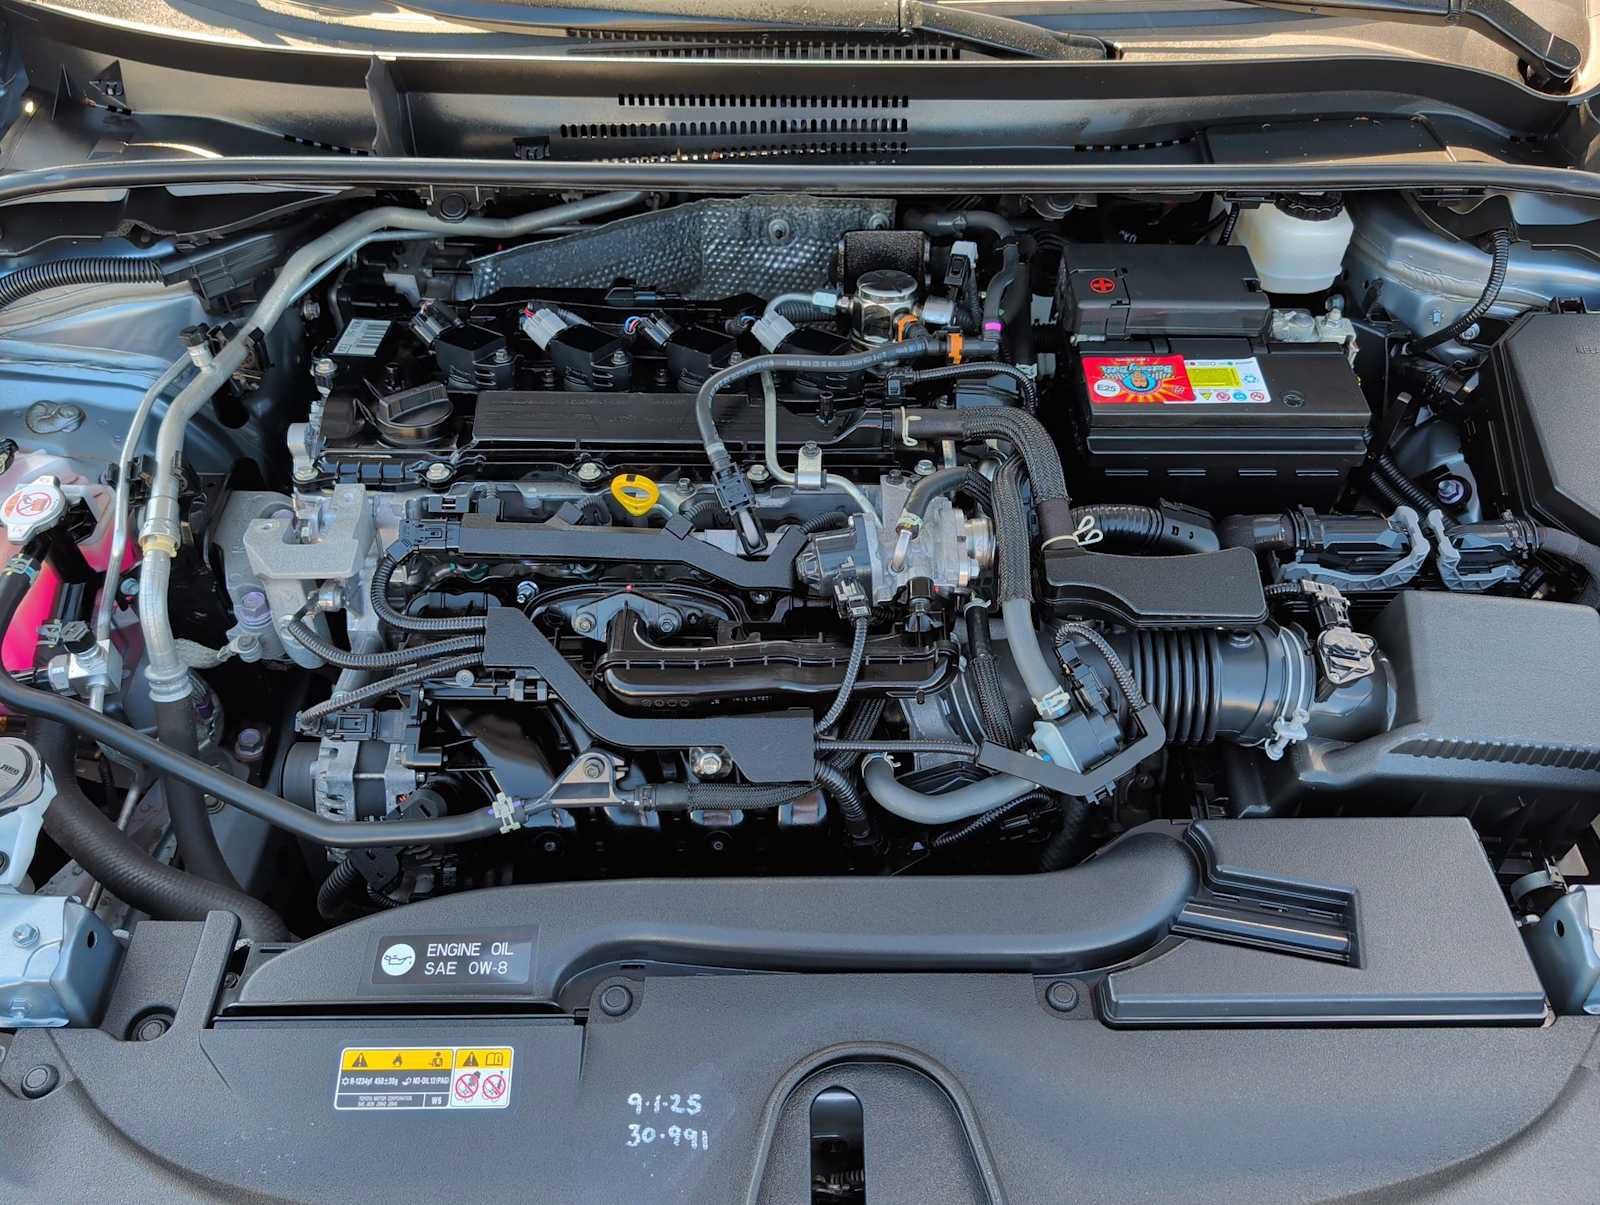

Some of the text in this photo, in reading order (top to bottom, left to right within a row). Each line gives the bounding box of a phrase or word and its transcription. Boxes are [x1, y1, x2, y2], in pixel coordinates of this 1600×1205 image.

[426, 942, 514, 957] ENGINE OIL
[424, 961, 457, 975] SAE
